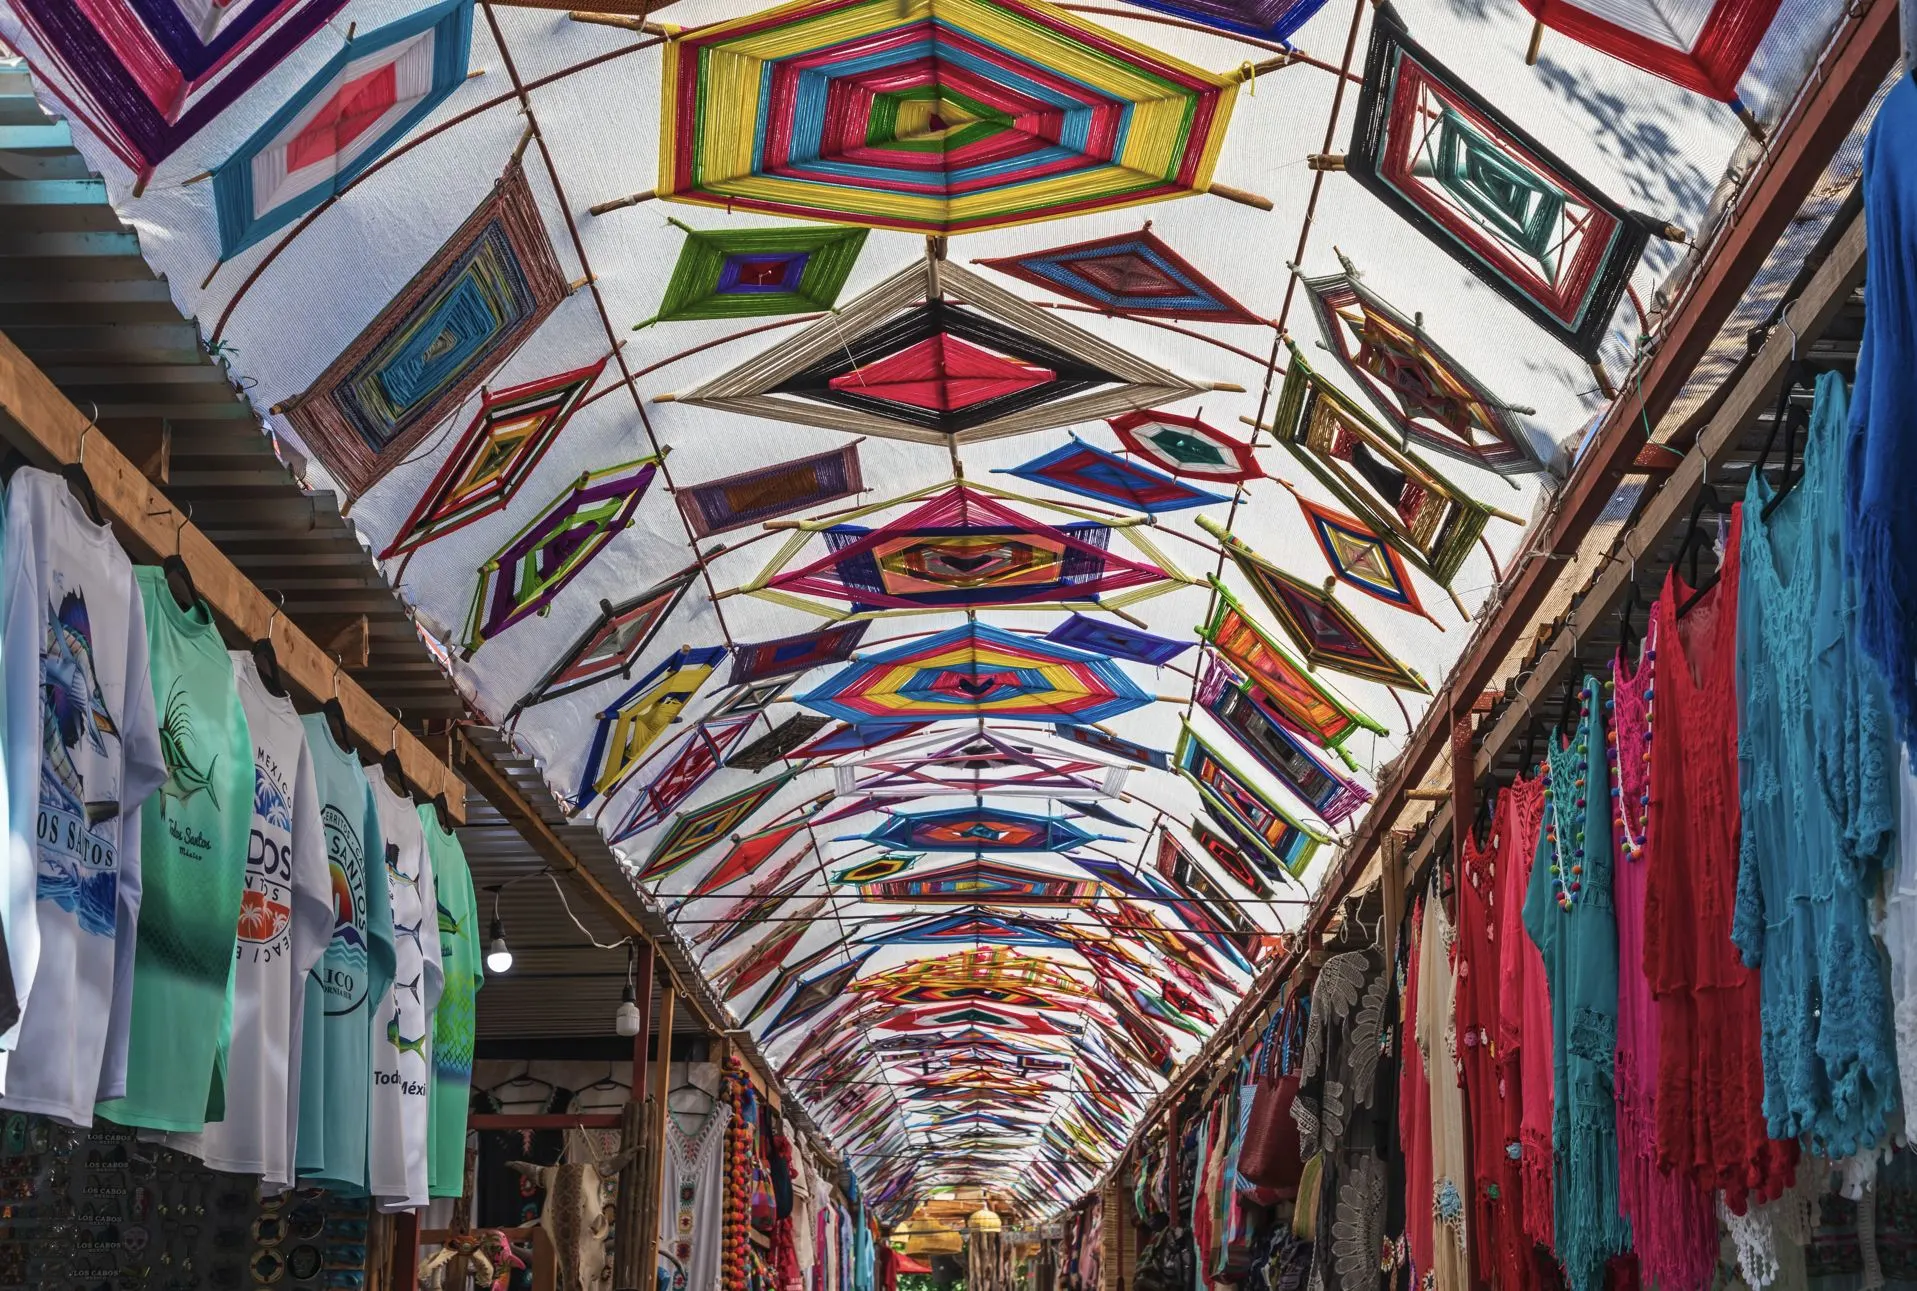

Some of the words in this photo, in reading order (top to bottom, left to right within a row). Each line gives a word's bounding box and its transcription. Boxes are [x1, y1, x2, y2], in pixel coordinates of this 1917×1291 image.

[257, 746, 292, 809] MEXICO
[331, 835, 367, 932] SANTOS
[324, 968, 354, 992] ICO
